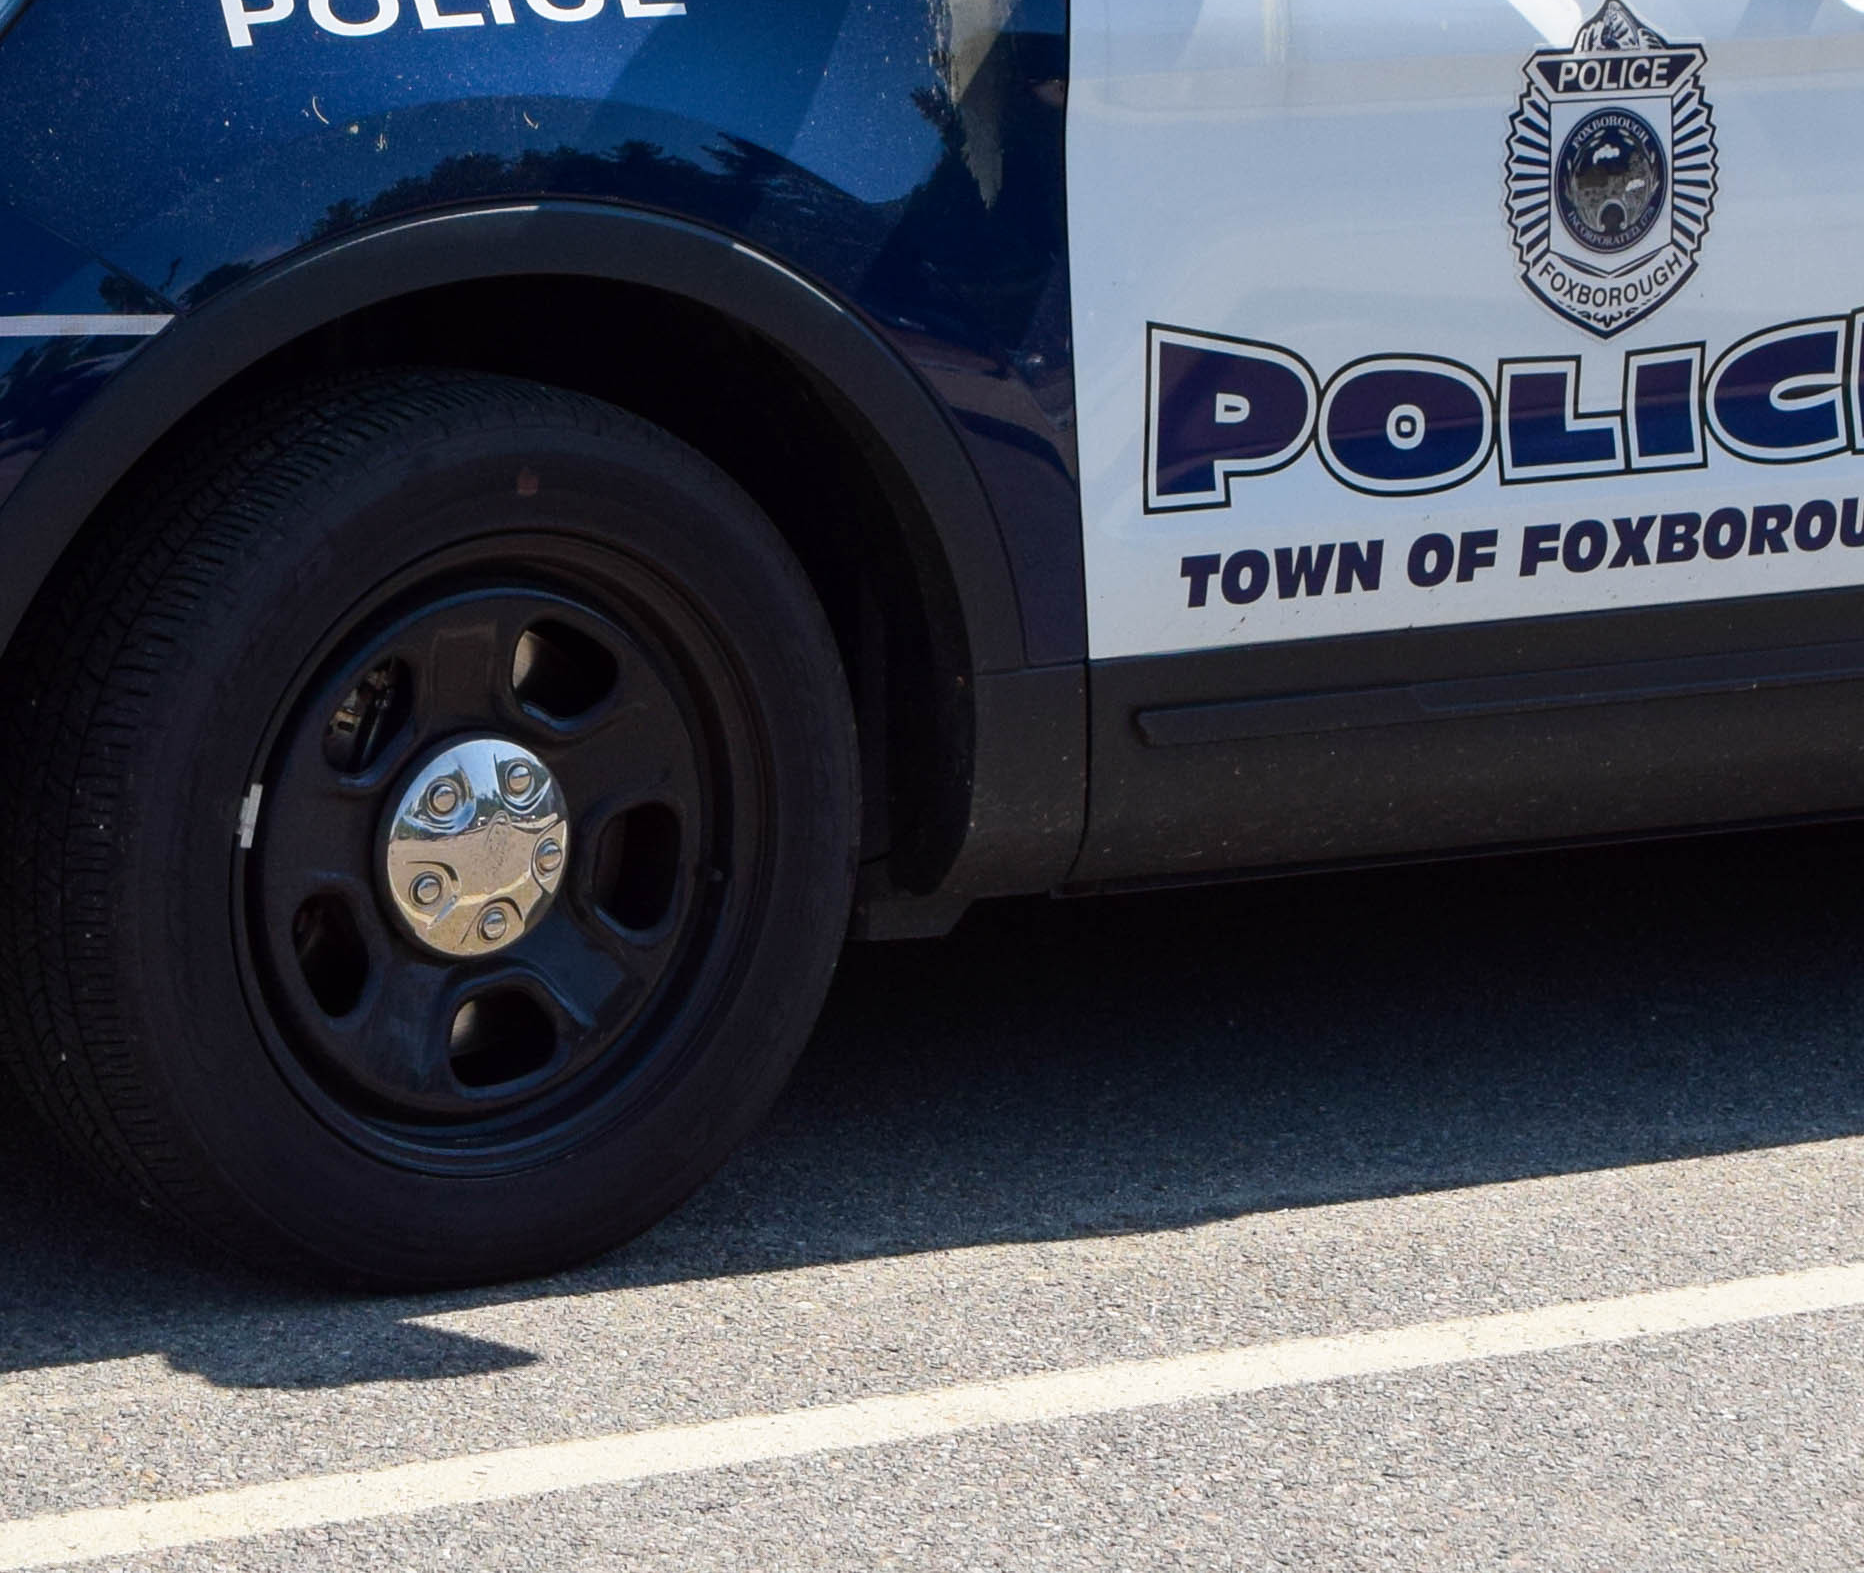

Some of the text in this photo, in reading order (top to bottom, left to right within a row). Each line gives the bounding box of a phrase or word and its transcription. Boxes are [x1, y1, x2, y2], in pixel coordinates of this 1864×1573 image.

[1557, 57, 1671, 92] POLICE
[1572, 115, 1650, 149] FOXBOROUGH
[1538, 252, 1683, 307] FOXBOROUGH
[1180, 539, 1385, 608] TOWN
[1407, 529, 1499, 588] OF
